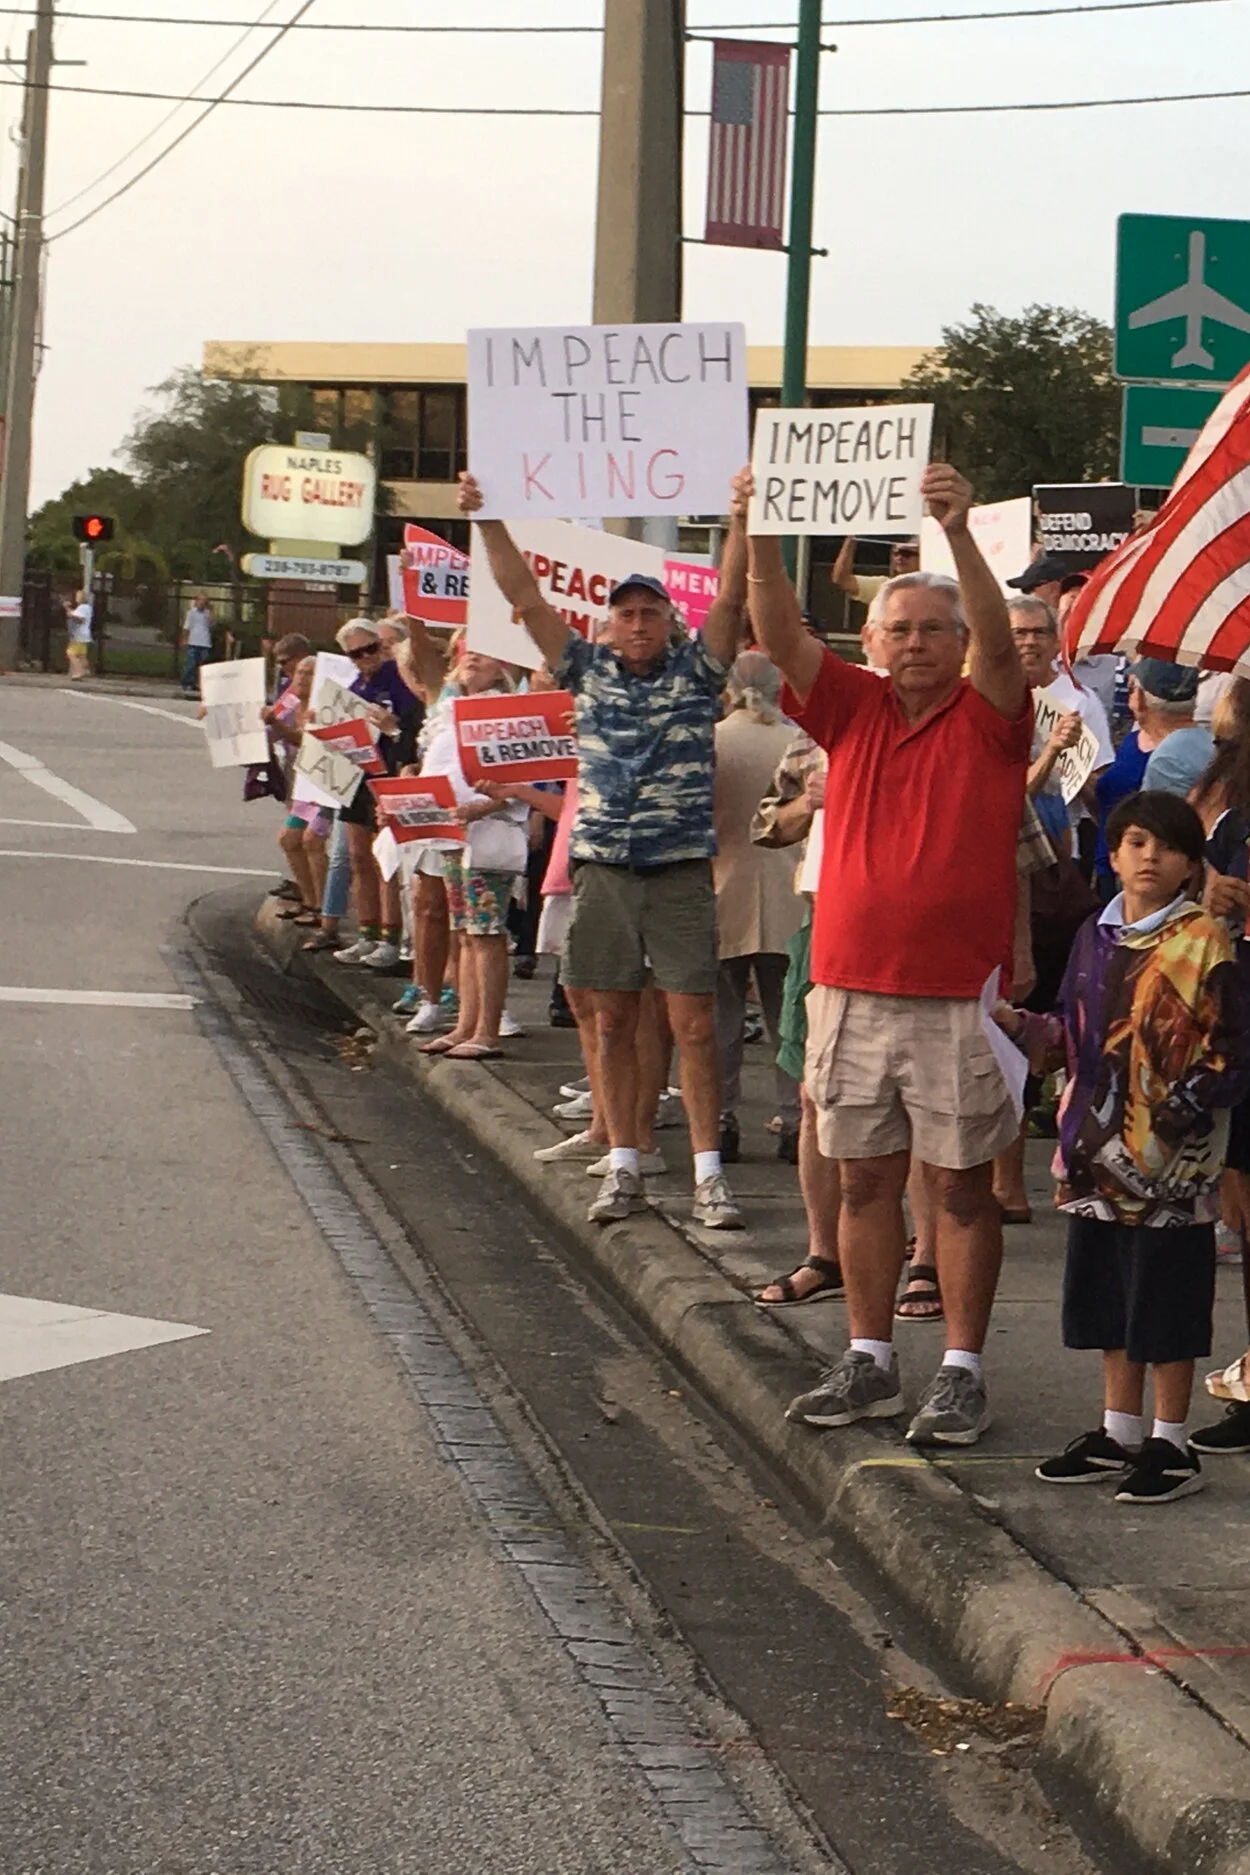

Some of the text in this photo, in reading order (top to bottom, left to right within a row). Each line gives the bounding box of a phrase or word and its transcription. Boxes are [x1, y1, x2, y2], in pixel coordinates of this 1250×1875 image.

[486, 332, 732, 387] IMPEACH
[551, 391, 642, 442] THE
[769, 417, 916, 464] IMPEACH
[286, 456, 342, 474] NAPLES
[522, 449, 685, 500] KING
[261, 473, 366, 508] RUG GALLERY
[764, 477, 907, 524] REMOVE
[1040, 512, 1092, 531] DEFEND
[421, 572, 437, 595] &
[462, 720, 543, 742] IMPEACH
[481, 738, 575, 764] & REMOVE
